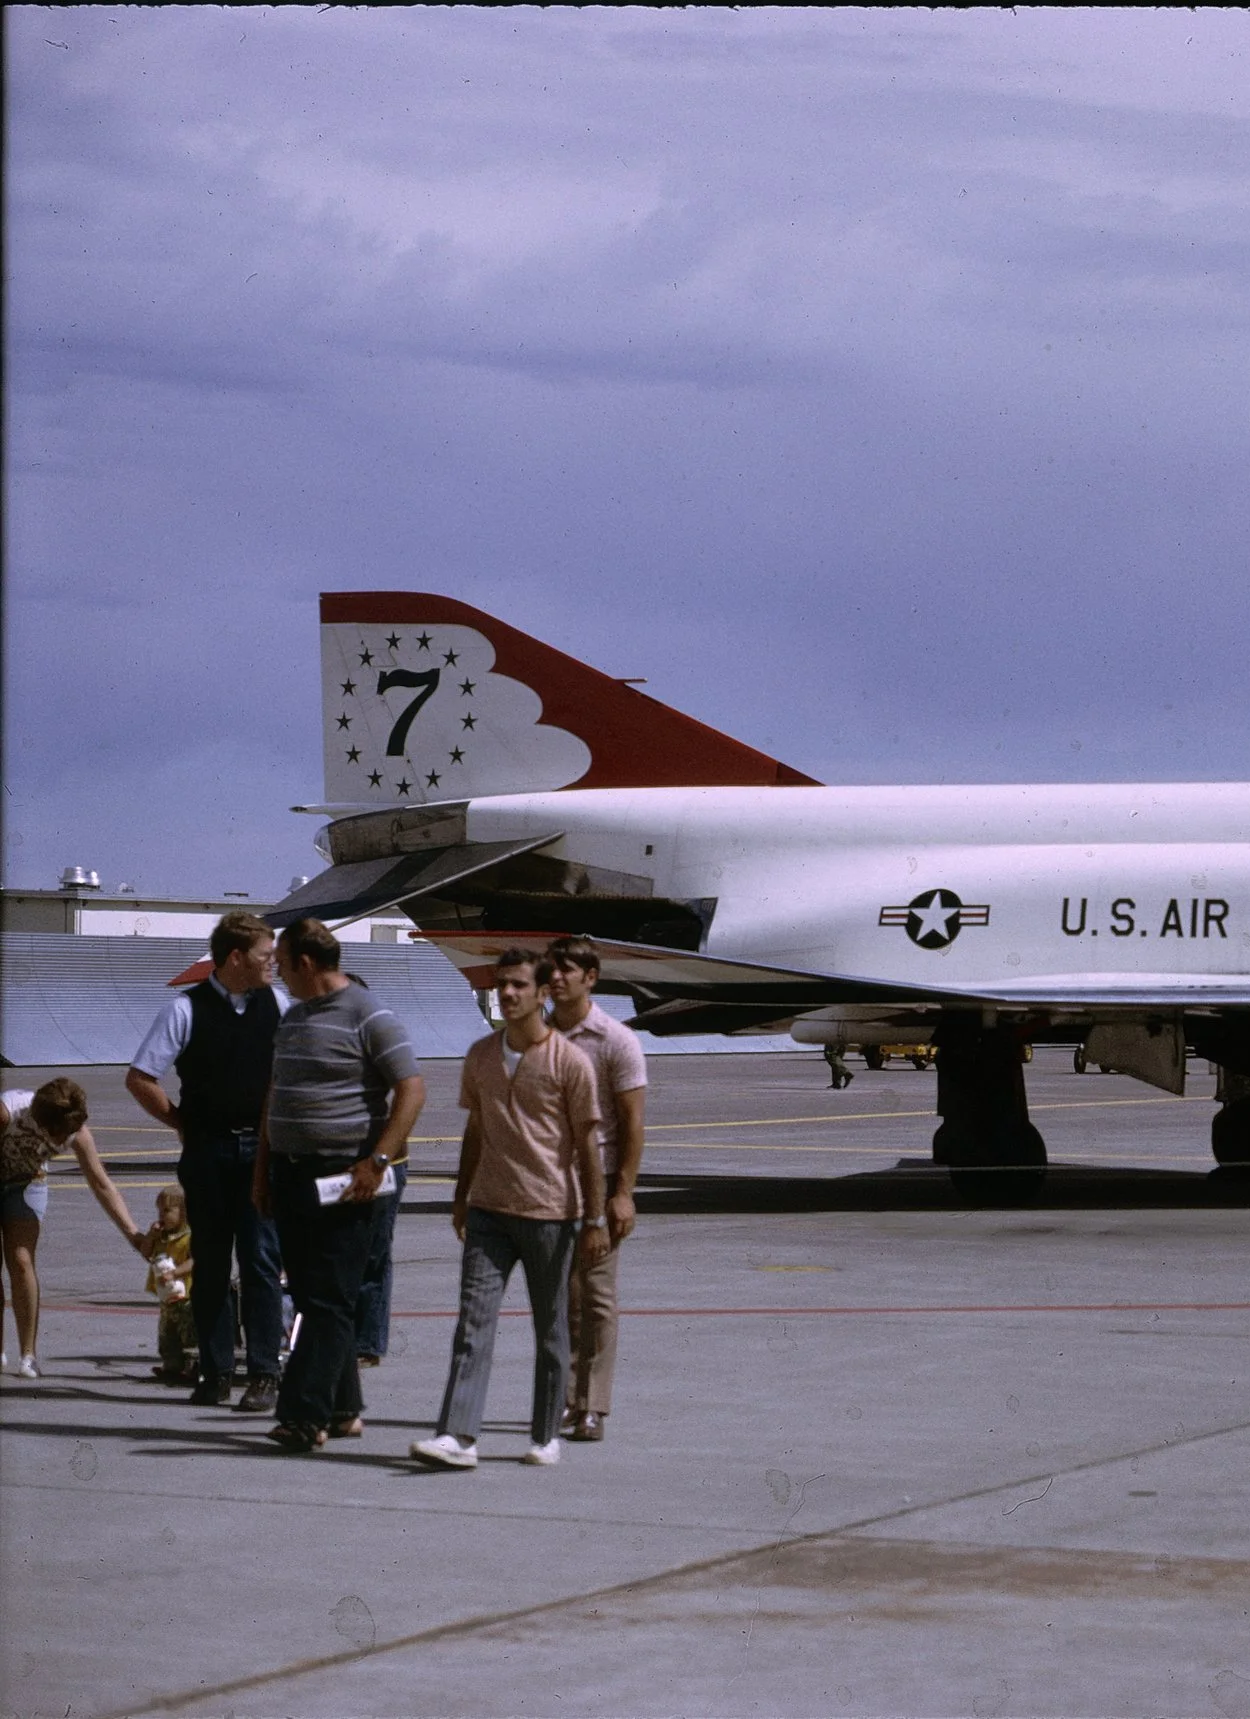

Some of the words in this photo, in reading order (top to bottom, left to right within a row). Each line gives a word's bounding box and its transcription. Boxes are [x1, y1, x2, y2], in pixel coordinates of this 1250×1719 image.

[375, 667, 441, 756] 7
[1060, 897, 1148, 937] U.S.
[1159, 897, 1230, 938] AIR
